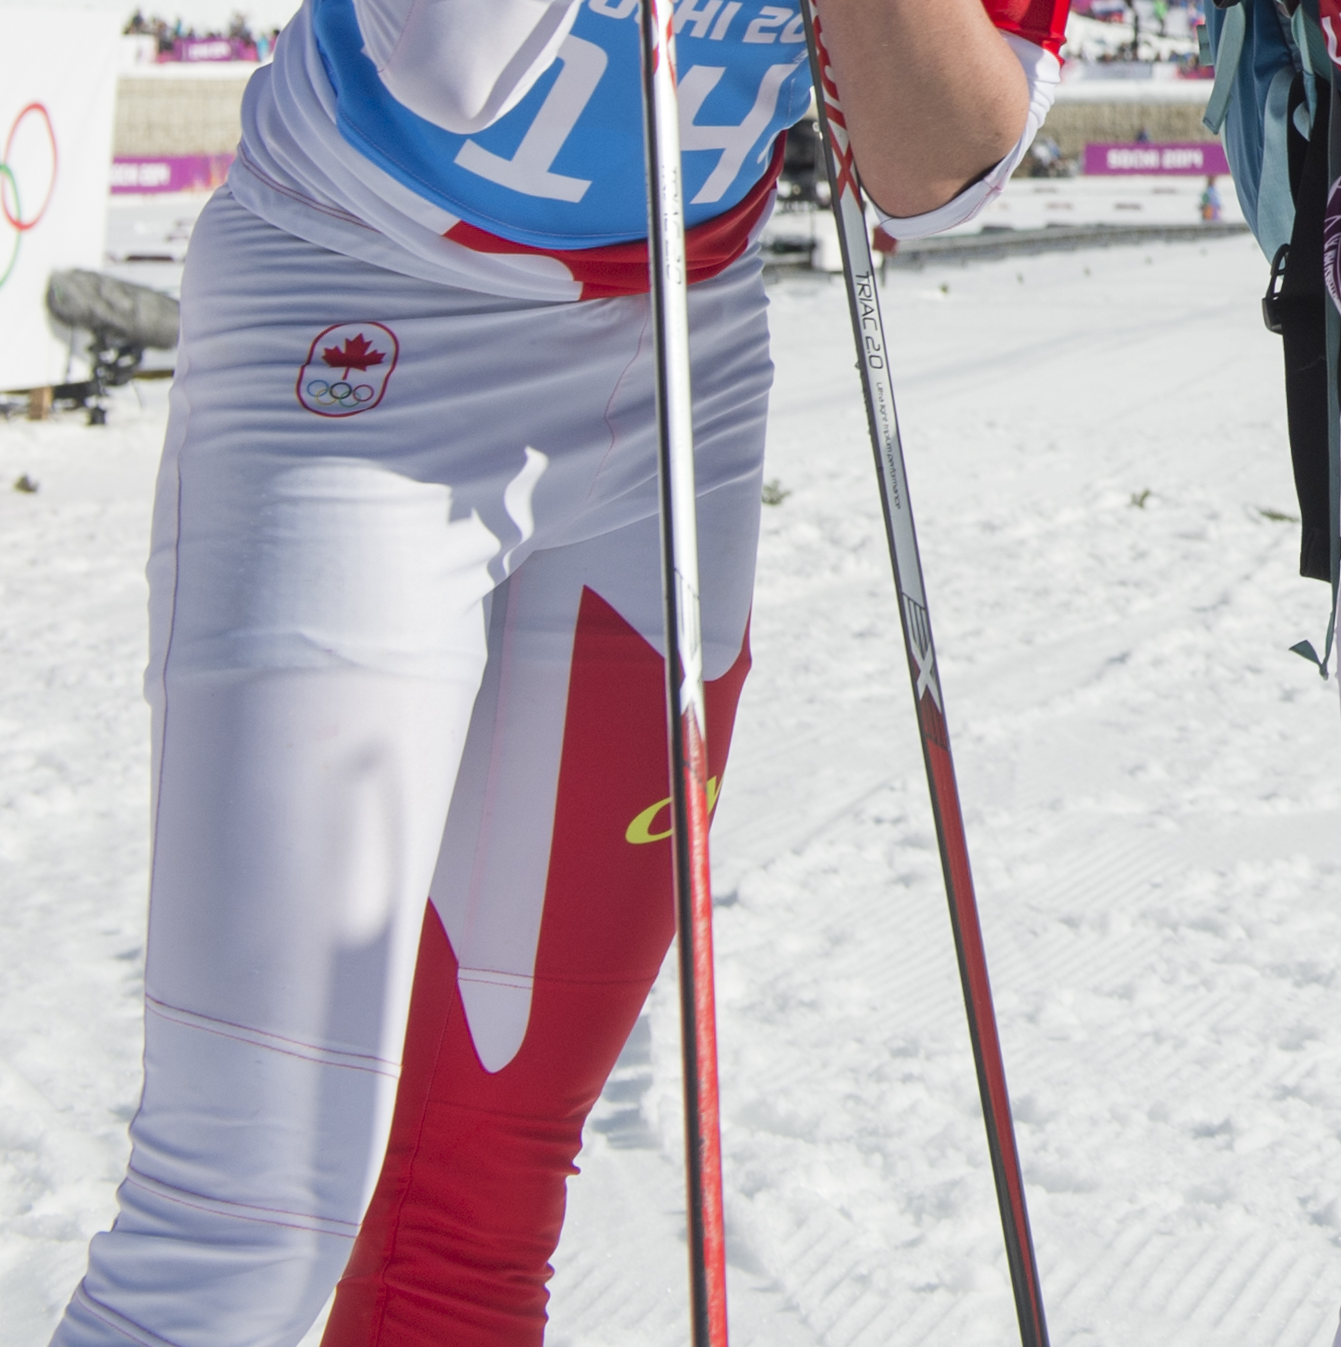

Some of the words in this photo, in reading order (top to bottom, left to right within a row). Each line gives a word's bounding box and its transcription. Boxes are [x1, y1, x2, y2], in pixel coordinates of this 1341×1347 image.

[453, 33, 797, 205] 14
[855, 270, 880, 333] TRIAC
[864, 333, 884, 370] 2.0
